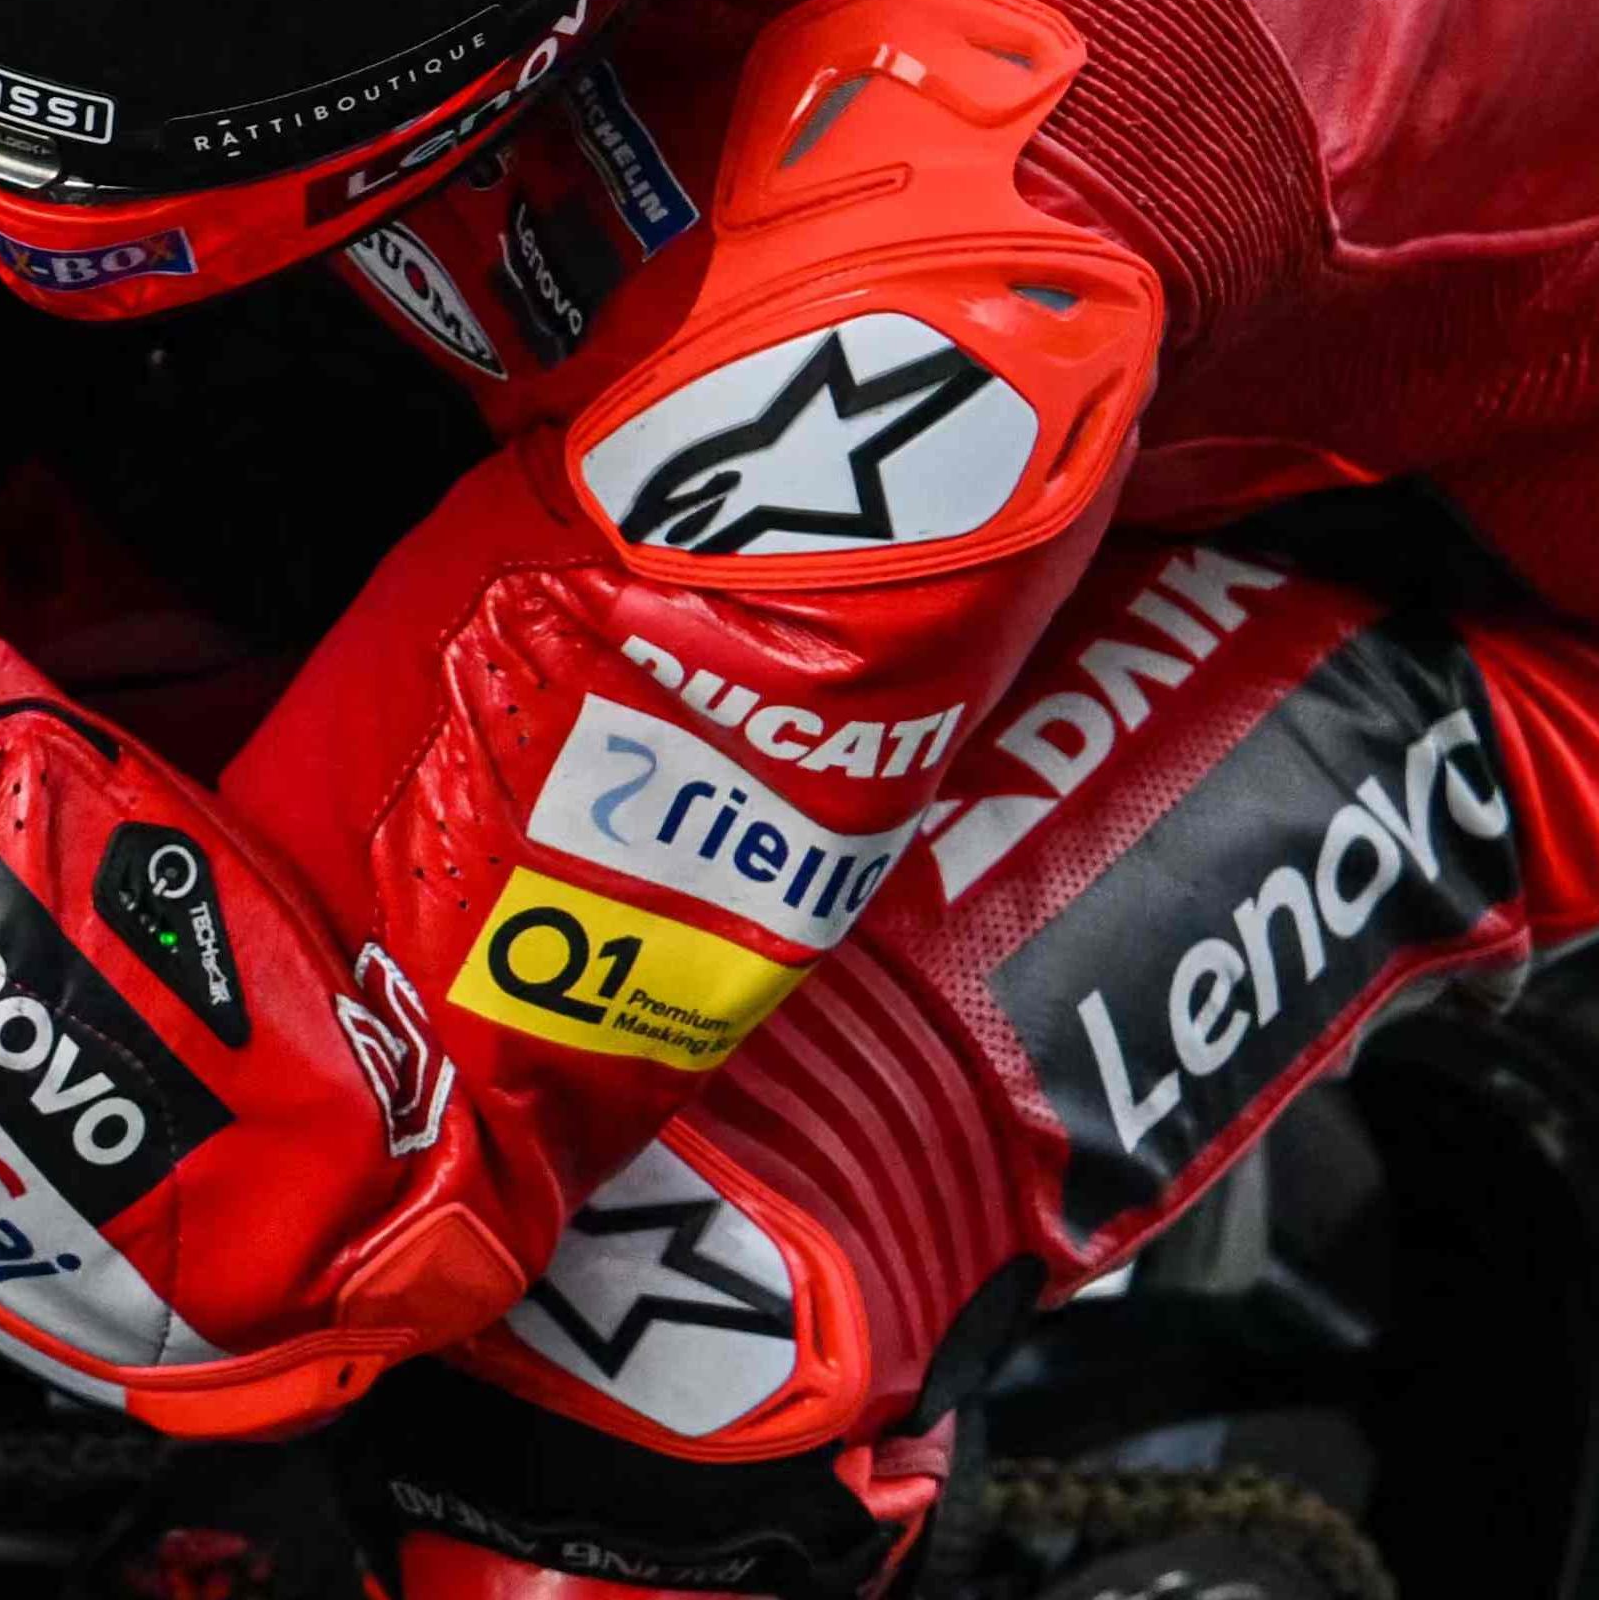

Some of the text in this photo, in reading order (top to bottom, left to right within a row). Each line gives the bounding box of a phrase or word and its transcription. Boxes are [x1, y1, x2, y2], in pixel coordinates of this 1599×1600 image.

[517, 202, 584, 336] Lenovo
[486, 906, 644, 1025] Q1
[1077, 708, 1509, 1155] Lenovo
[612, 1012, 708, 1054] Masking
[627, 988, 730, 1032] Premium
